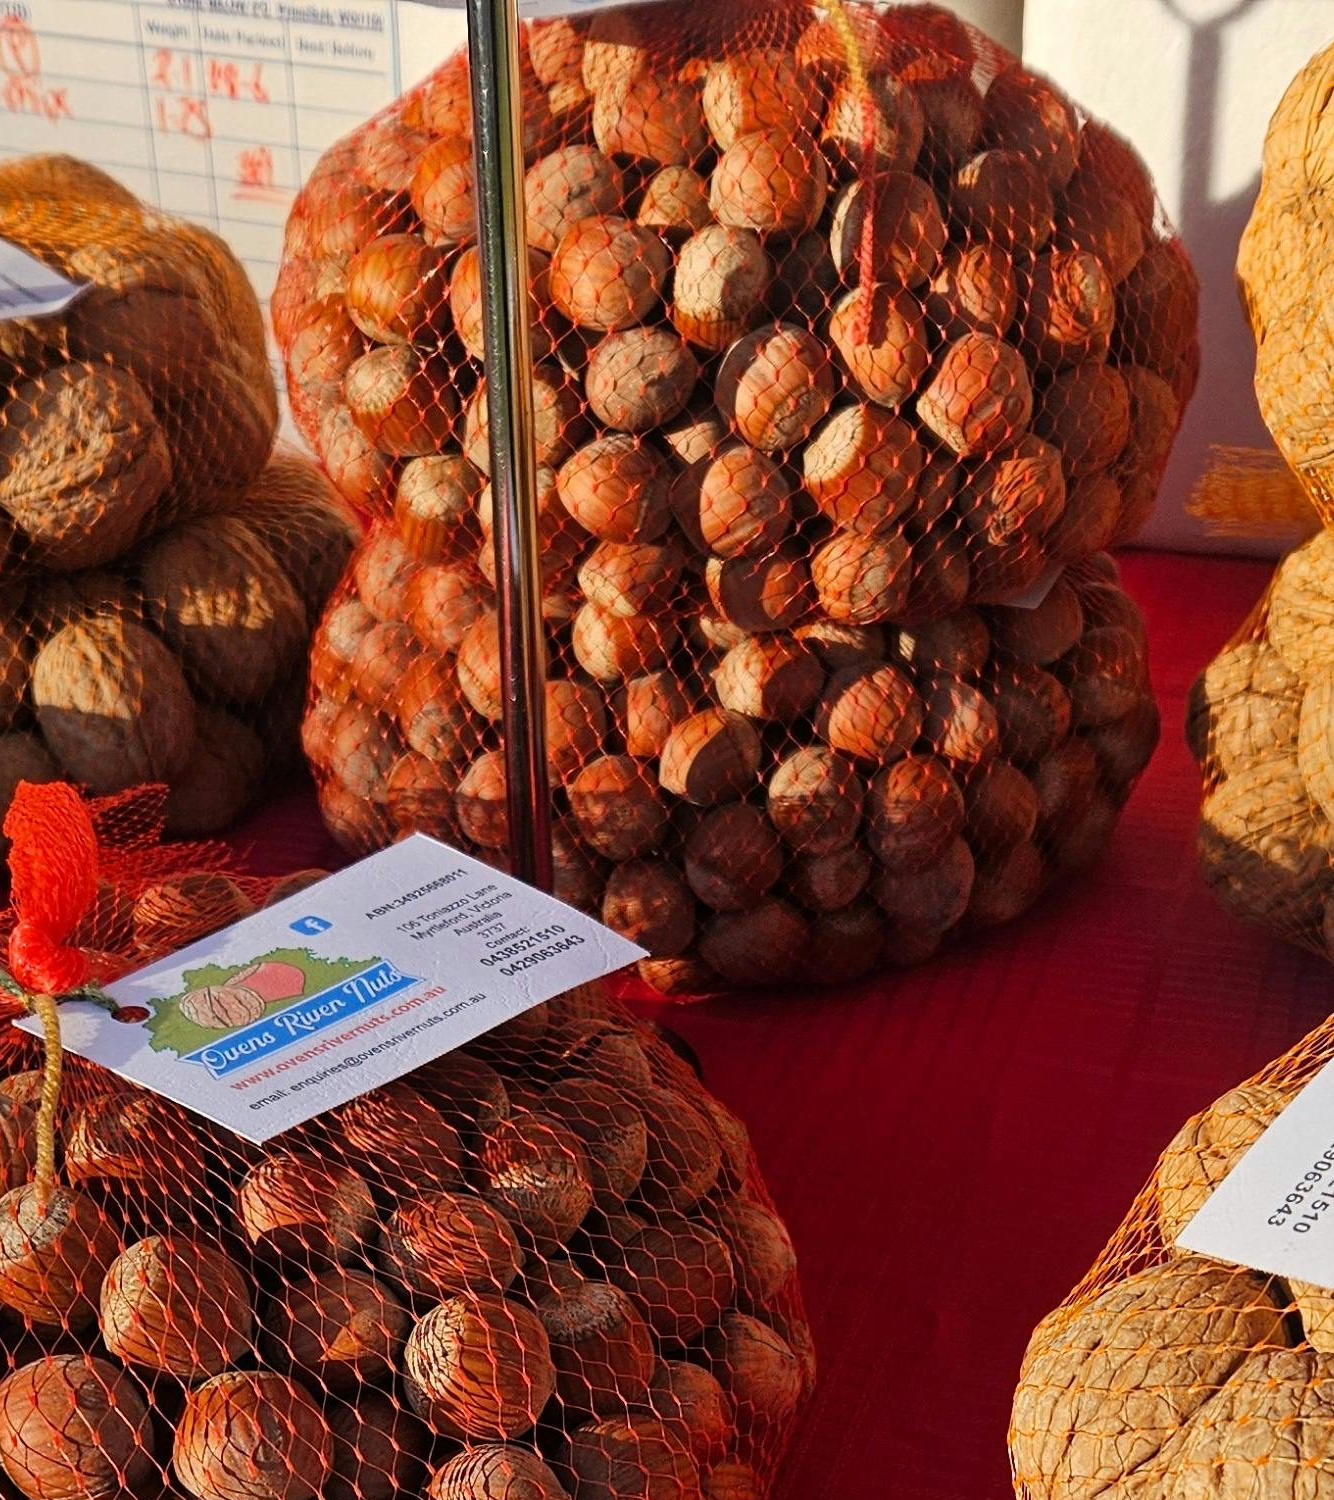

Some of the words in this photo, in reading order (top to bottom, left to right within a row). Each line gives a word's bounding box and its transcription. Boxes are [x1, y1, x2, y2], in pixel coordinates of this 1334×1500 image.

[366, 868, 468, 921] ABN:34925668011
[396, 917, 419, 934] 106
[417, 898, 469, 925] Toniazzo
[467, 882, 498, 901] Lane
[410, 910, 474, 942] Myrtleford,
[471, 890, 512, 914] Victoria
[453, 910, 503, 937] Australia
[477, 922, 507, 940] 3737
[479, 924, 566, 967] 0438521510
[485, 925, 530, 950] Contact:
[499, 934, 586, 977] 0429063643
[201, 1029, 276, 1073] Ovens
[273, 998, 346, 1037] River
[343, 968, 403, 1004] Nuts
[230, 983, 447, 1092] www.ovensrivernuts.com.au
[248, 1087, 291, 1112] email:
[290, 991, 487, 1092] enquiries@ovensrivernuts.com.au
